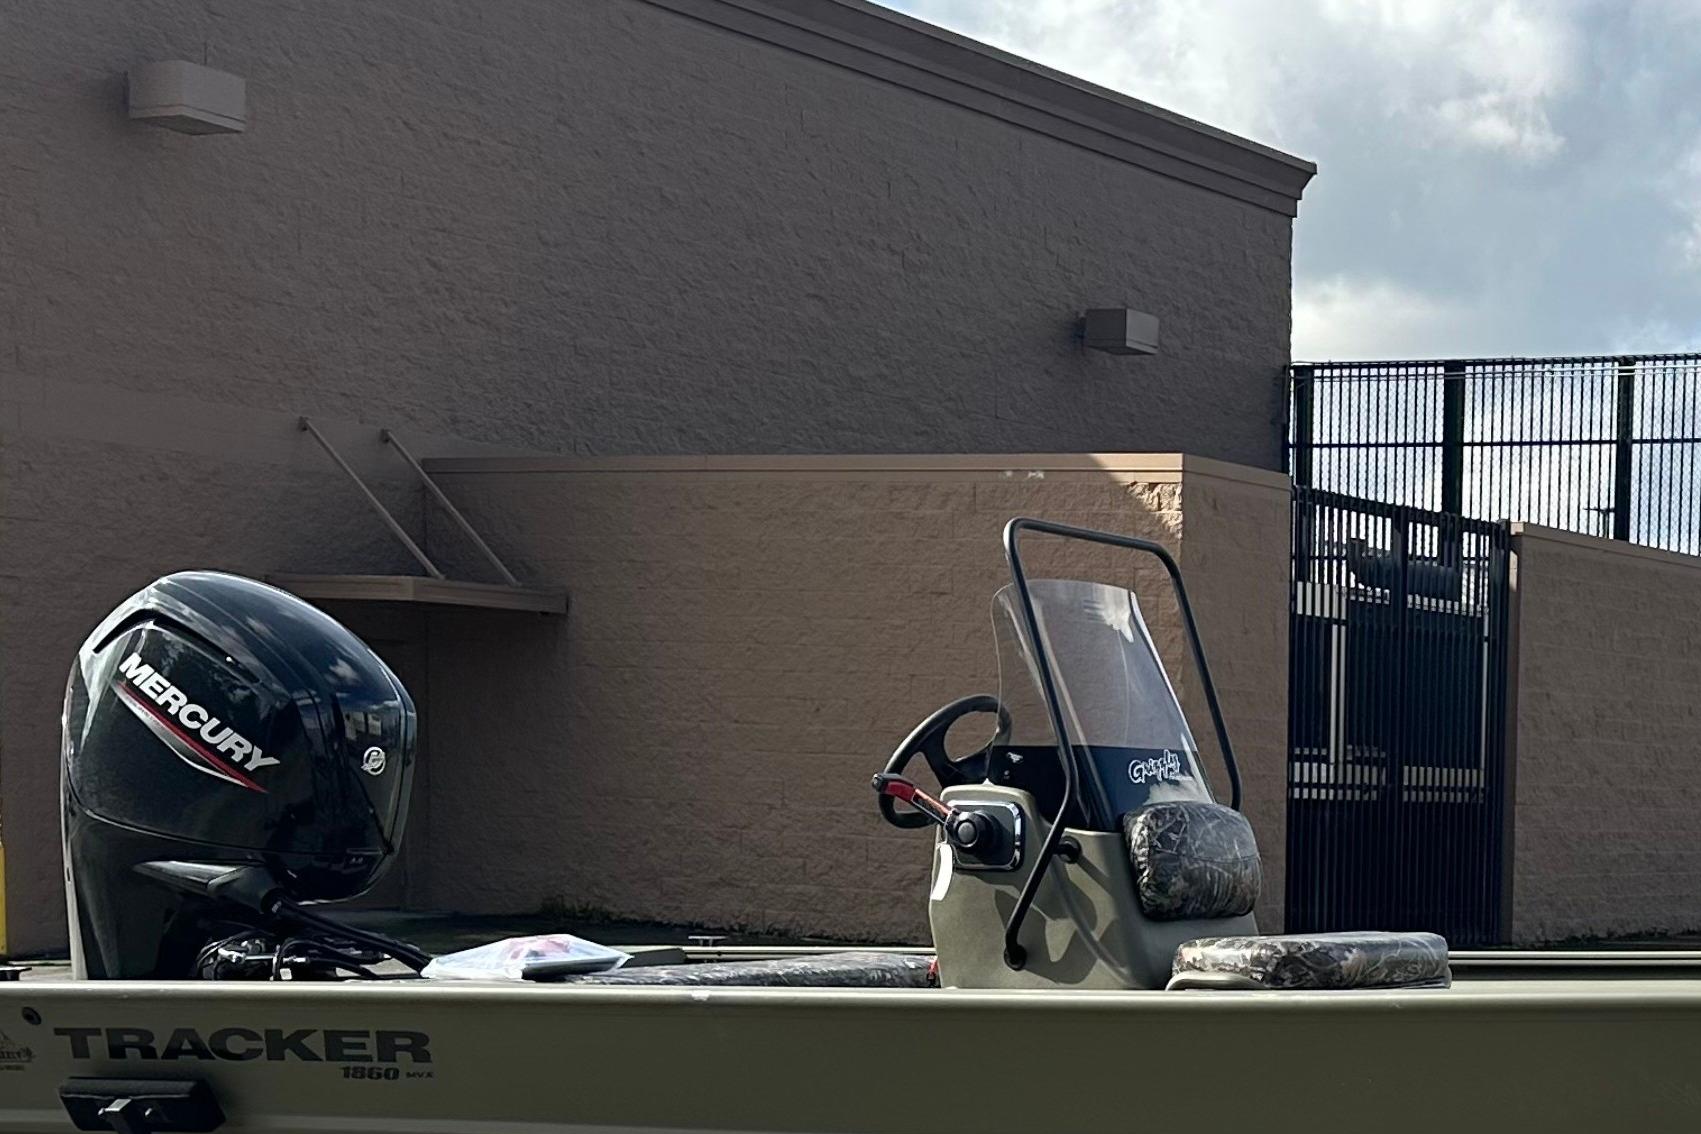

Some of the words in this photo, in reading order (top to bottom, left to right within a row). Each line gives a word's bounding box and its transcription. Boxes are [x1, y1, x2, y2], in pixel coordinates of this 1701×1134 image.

[118, 652, 281, 771] MERCURY
[53, 1027, 433, 1063] TRACKER
[341, 1066, 400, 1081] 1860
